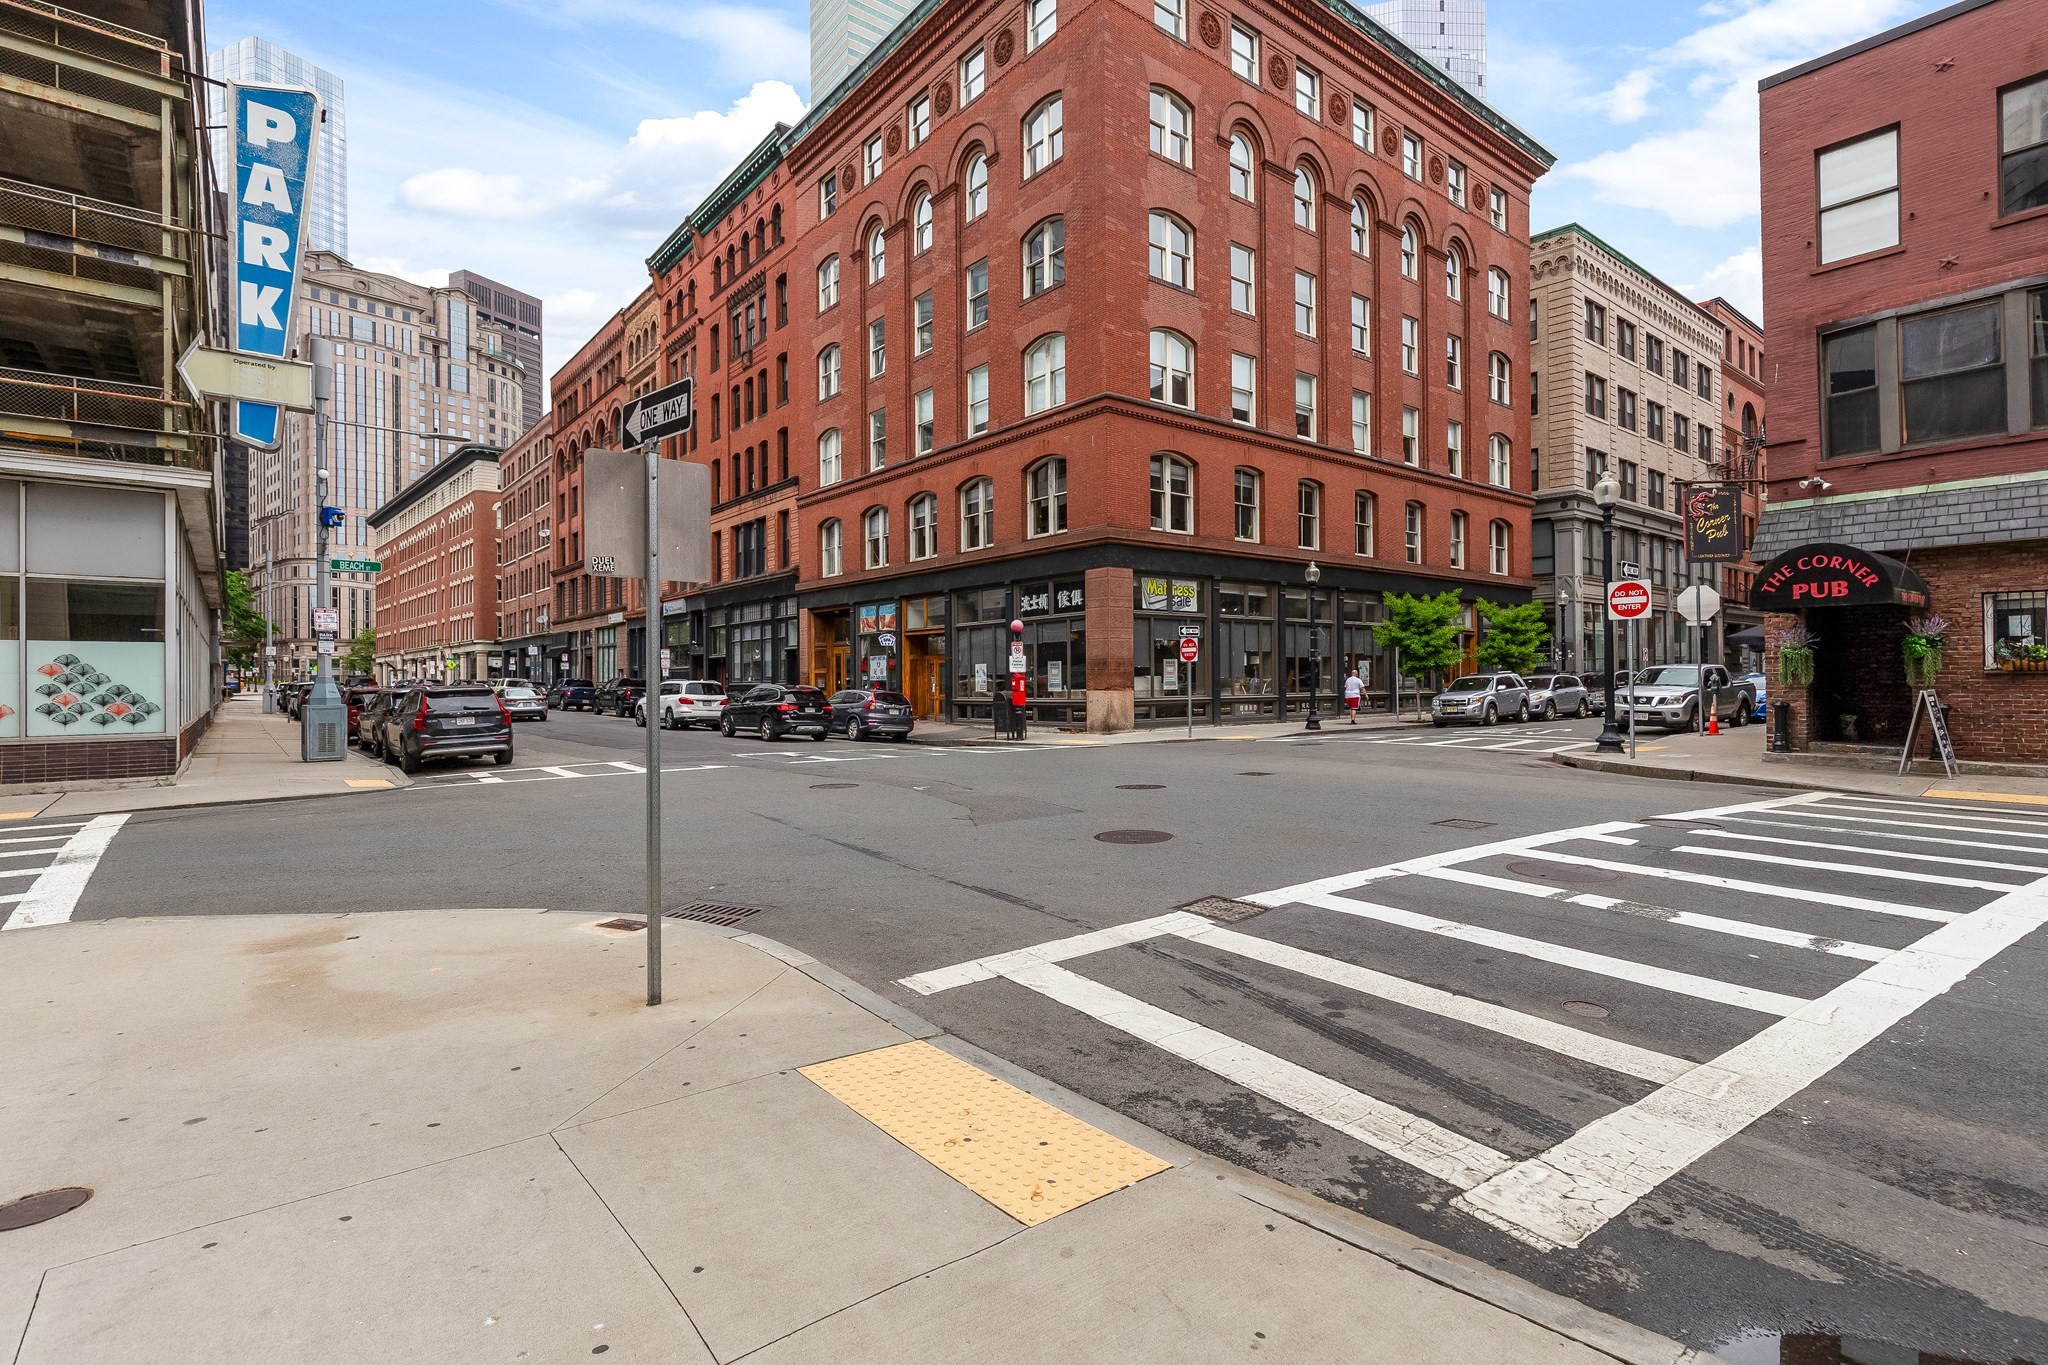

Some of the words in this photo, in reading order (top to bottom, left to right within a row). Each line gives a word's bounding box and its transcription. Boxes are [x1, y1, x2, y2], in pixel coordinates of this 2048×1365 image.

[241, 99, 297, 331] PARK
[233, 358, 266, 369] Operated
[267, 363, 276, 371] by
[640, 406, 658, 430] ONE
[663, 396, 685, 420] WAY
[1707, 502, 1720, 512] The
[1696, 513, 1731, 533] Corner
[1705, 523, 1729, 543] Pub
[340, 561, 365, 571] BEACH
[592, 564, 615, 572] XEME
[1761, 564, 1795, 593] THE
[1797, 554, 1879, 588] CORNER
[1792, 580, 1849, 600] PUB
[1617, 603, 1641, 611] ENTER
